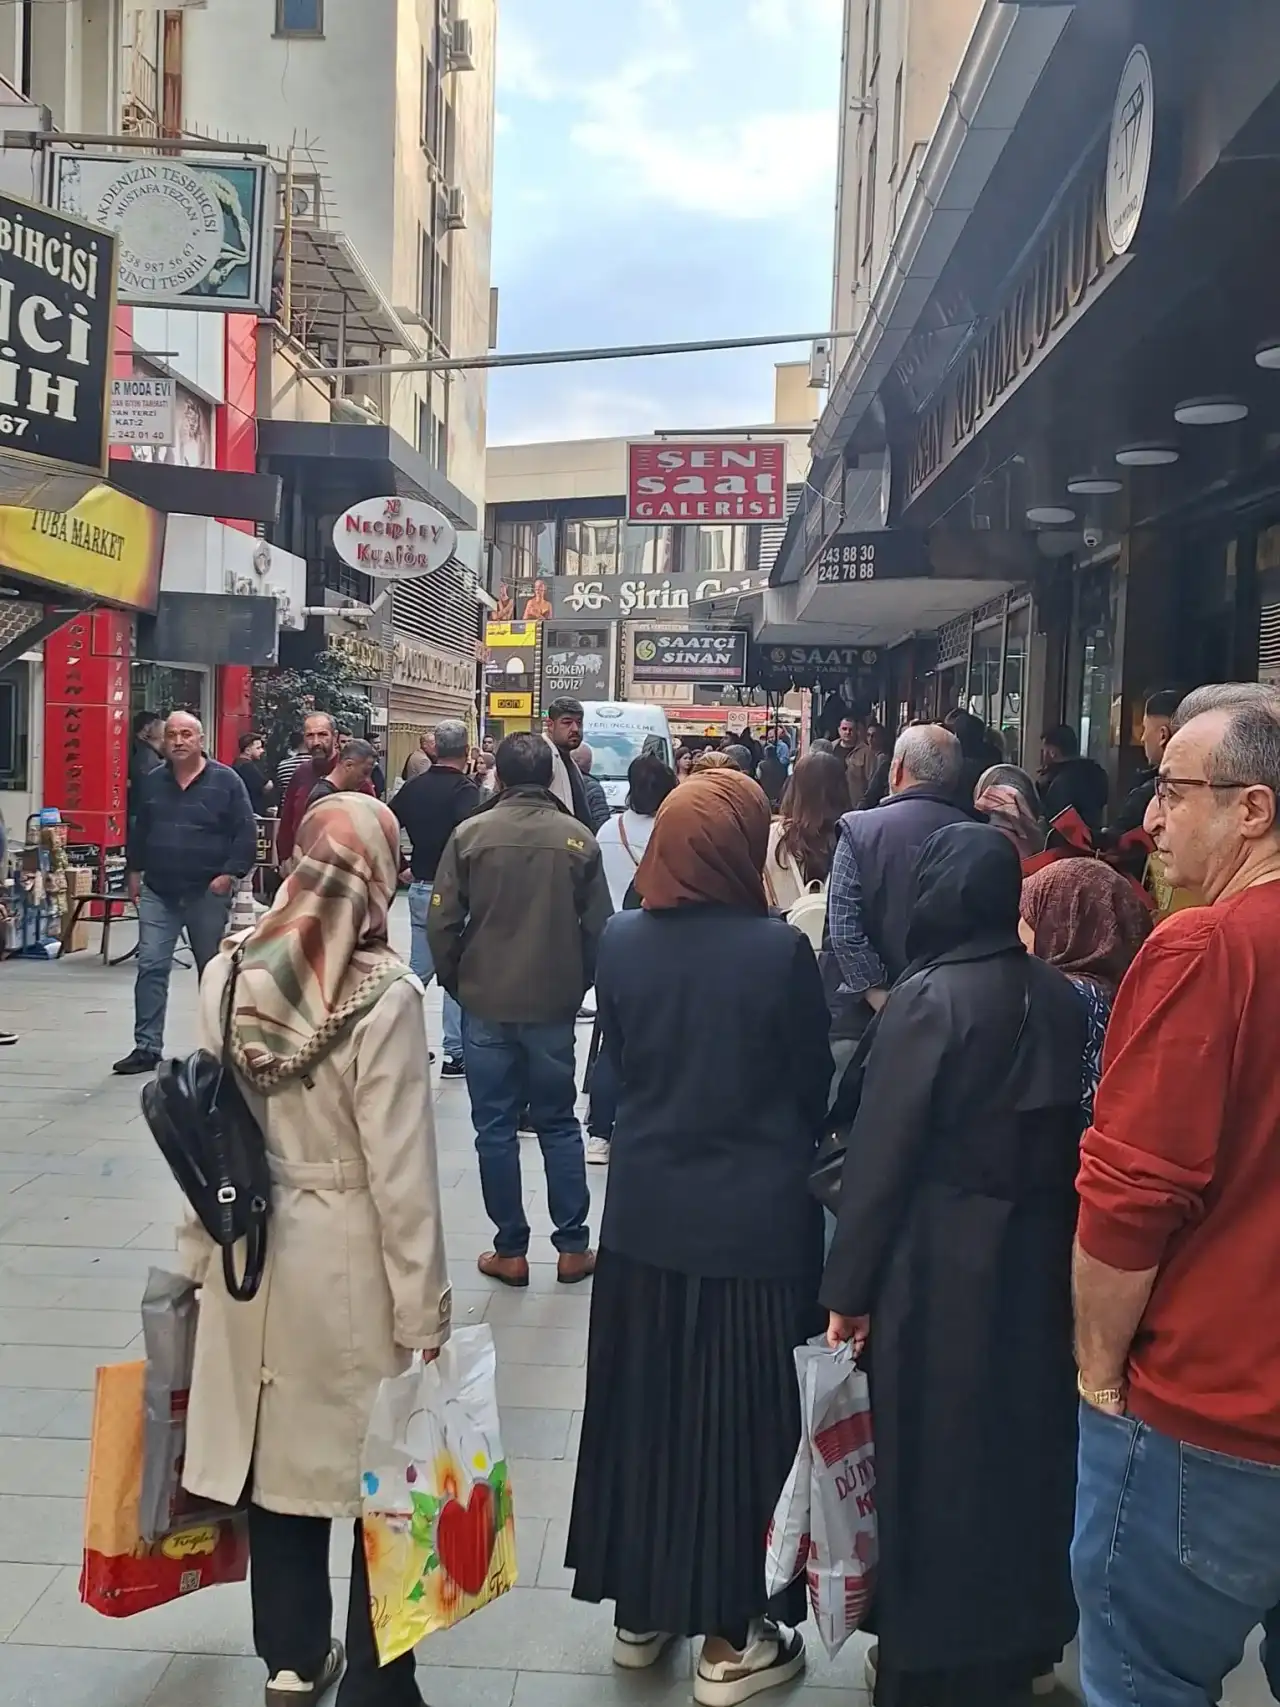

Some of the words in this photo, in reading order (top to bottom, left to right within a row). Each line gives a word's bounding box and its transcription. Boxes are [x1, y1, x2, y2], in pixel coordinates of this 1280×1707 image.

[115, 184, 160, 218] MUSTAFA
[163, 185, 198, 221] TEZCAN
[144, 262, 165, 272] 987
[169, 258, 183, 269] 56
[183, 242, 195, 257] 67
[124, 382, 152, 396] MODA
[155, 382, 171, 396] EVİ
[138, 431, 149, 439] 01
[152, 431, 165, 439] 40
[656, 450, 756, 472] ŞEN
[636, 497, 776, 516] GALERİSİ
[71, 518, 125, 561] MARKET
[820, 547, 840, 563] 243
[843, 546, 857, 562] 88
[860, 544, 875, 561] 30
[819, 564, 840, 581] 242
[842, 563, 857, 579] 78
[860, 563, 874, 579] 88
[619, 580, 689, 615] Şirin
[657, 635, 737, 651] SAATÇİ
[661, 649, 732, 664] SİNAN
[790, 648, 858, 664] SAAT
[545, 664, 585, 675] GÖRKEM
[550, 678, 580, 690] DÖVİZ
